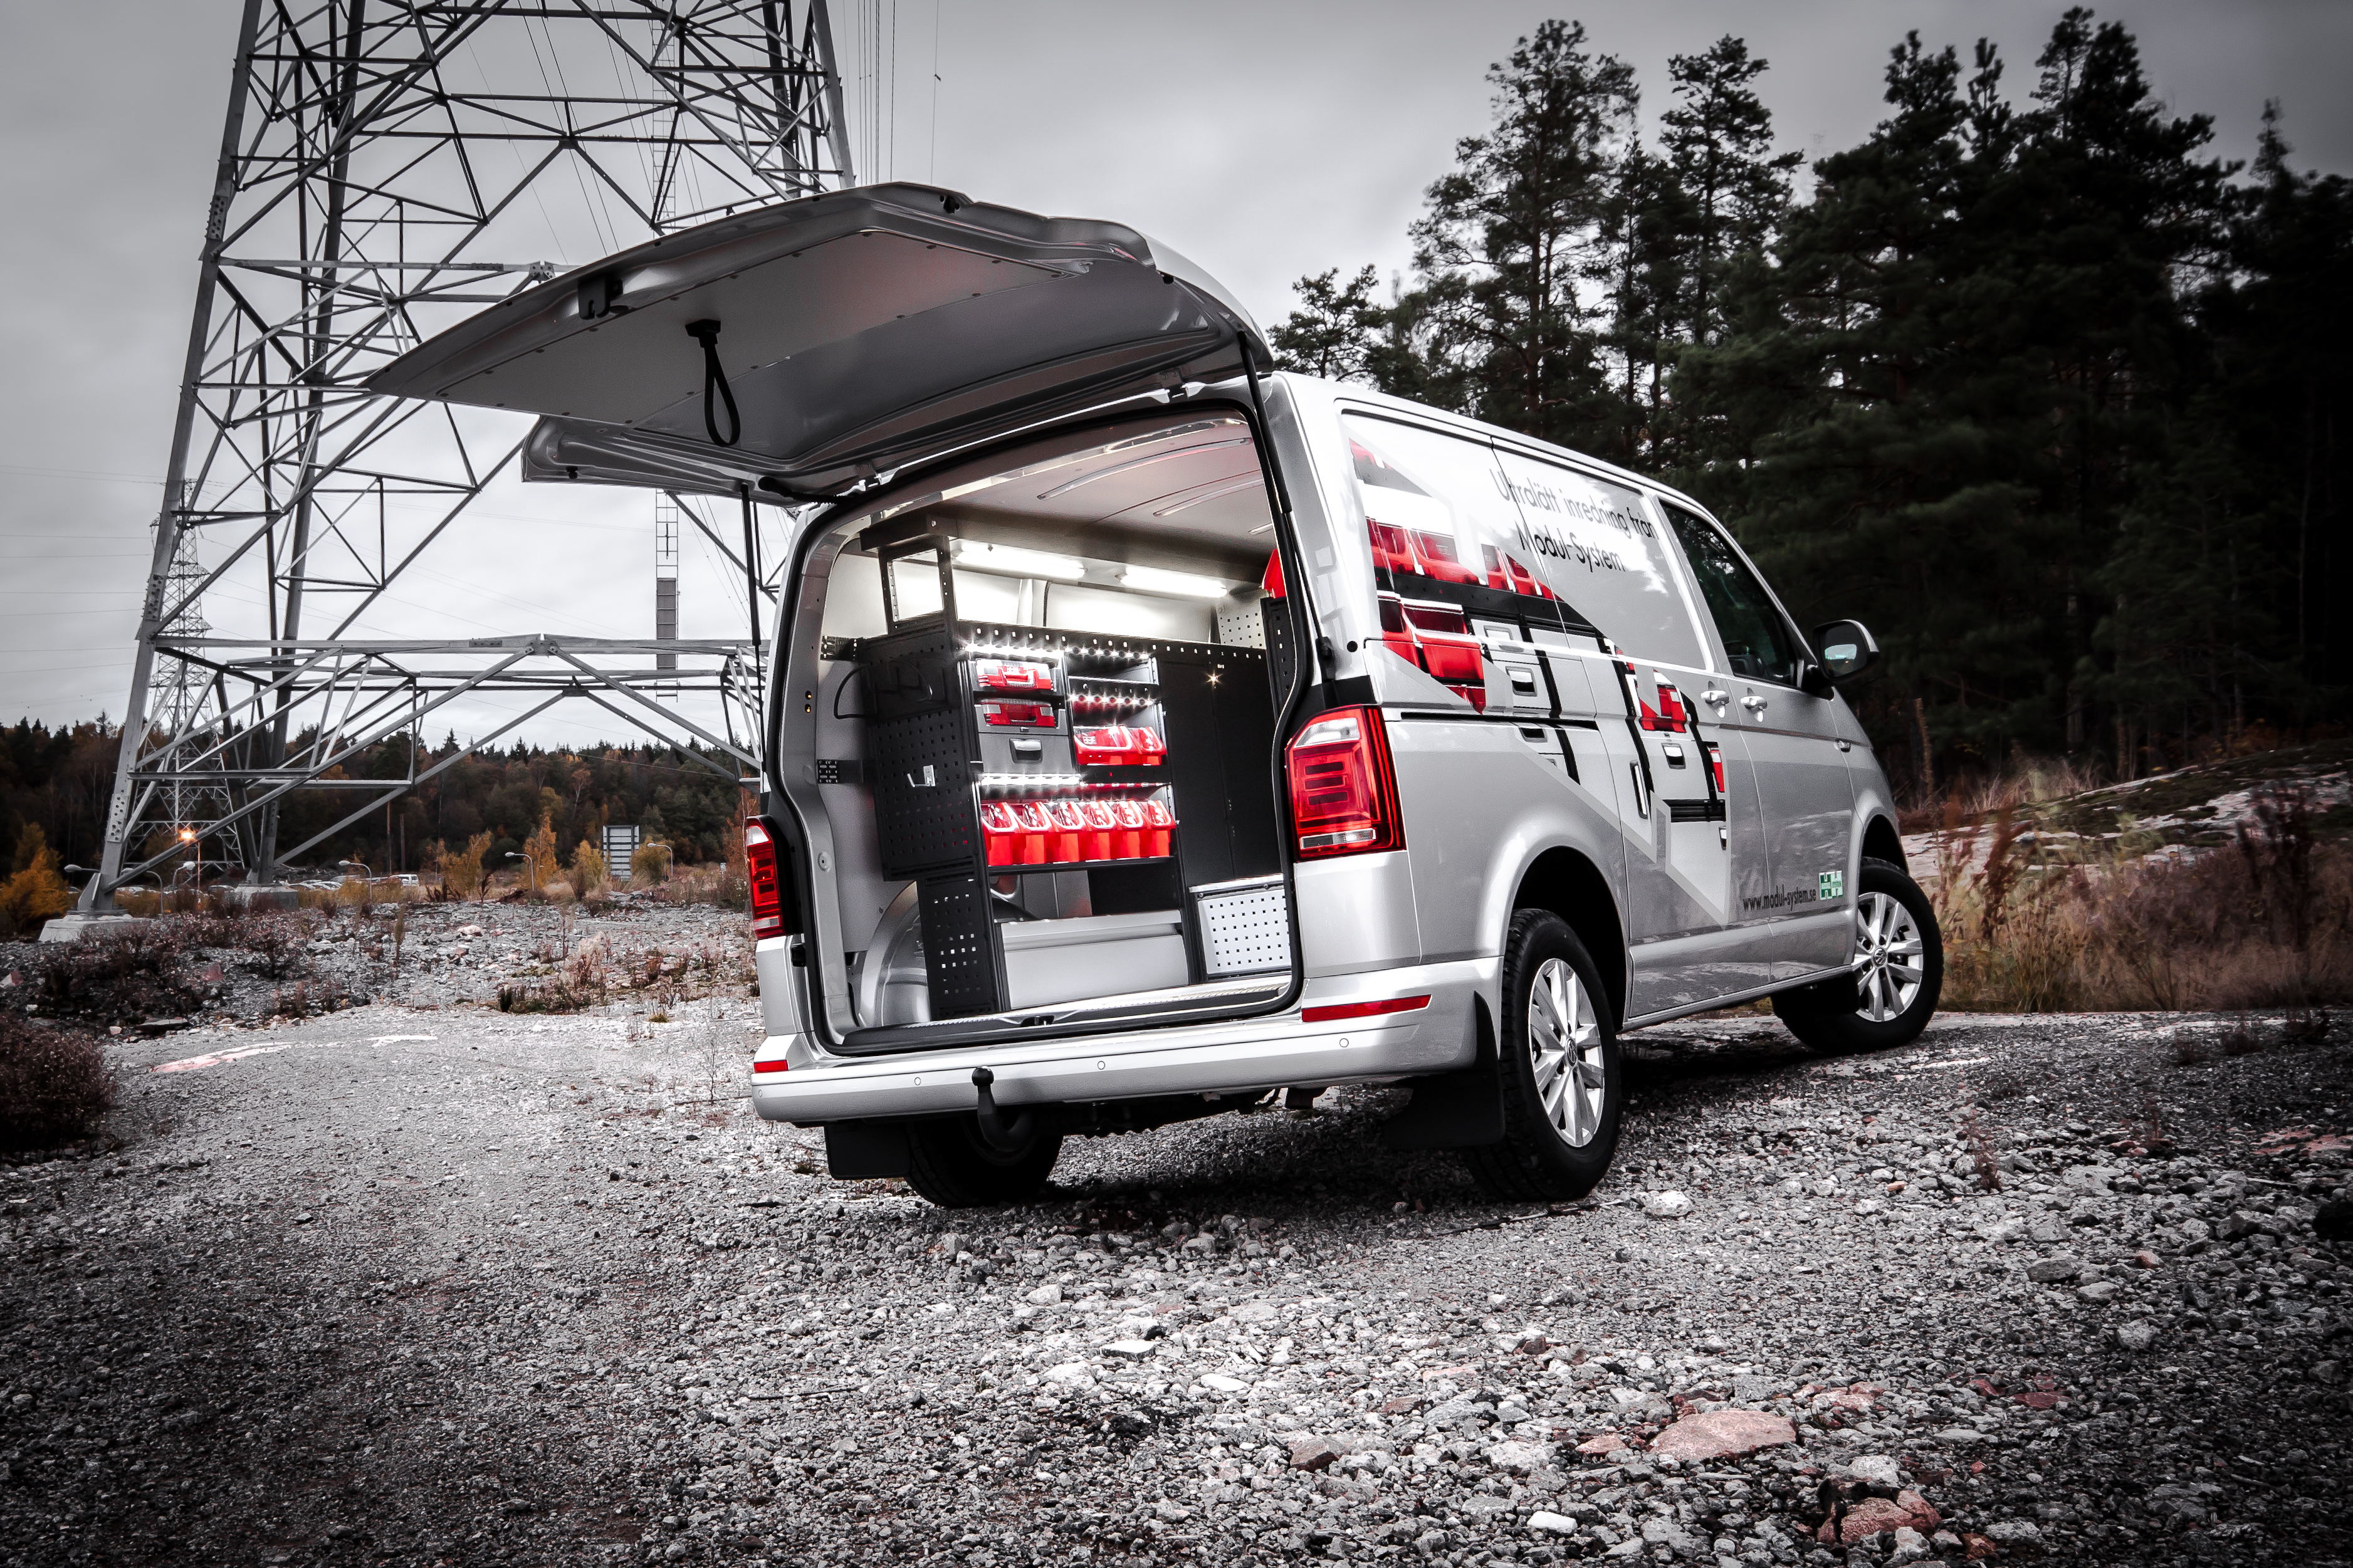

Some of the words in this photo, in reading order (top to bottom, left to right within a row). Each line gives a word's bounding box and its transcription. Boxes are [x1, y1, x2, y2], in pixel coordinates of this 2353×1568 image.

[1559, 488, 1632, 539] inredning
[1627, 506, 1660, 540] från
[1514, 519, 1626, 573] Modul-System
[1742, 883, 1816, 912] www.modul-system.se
